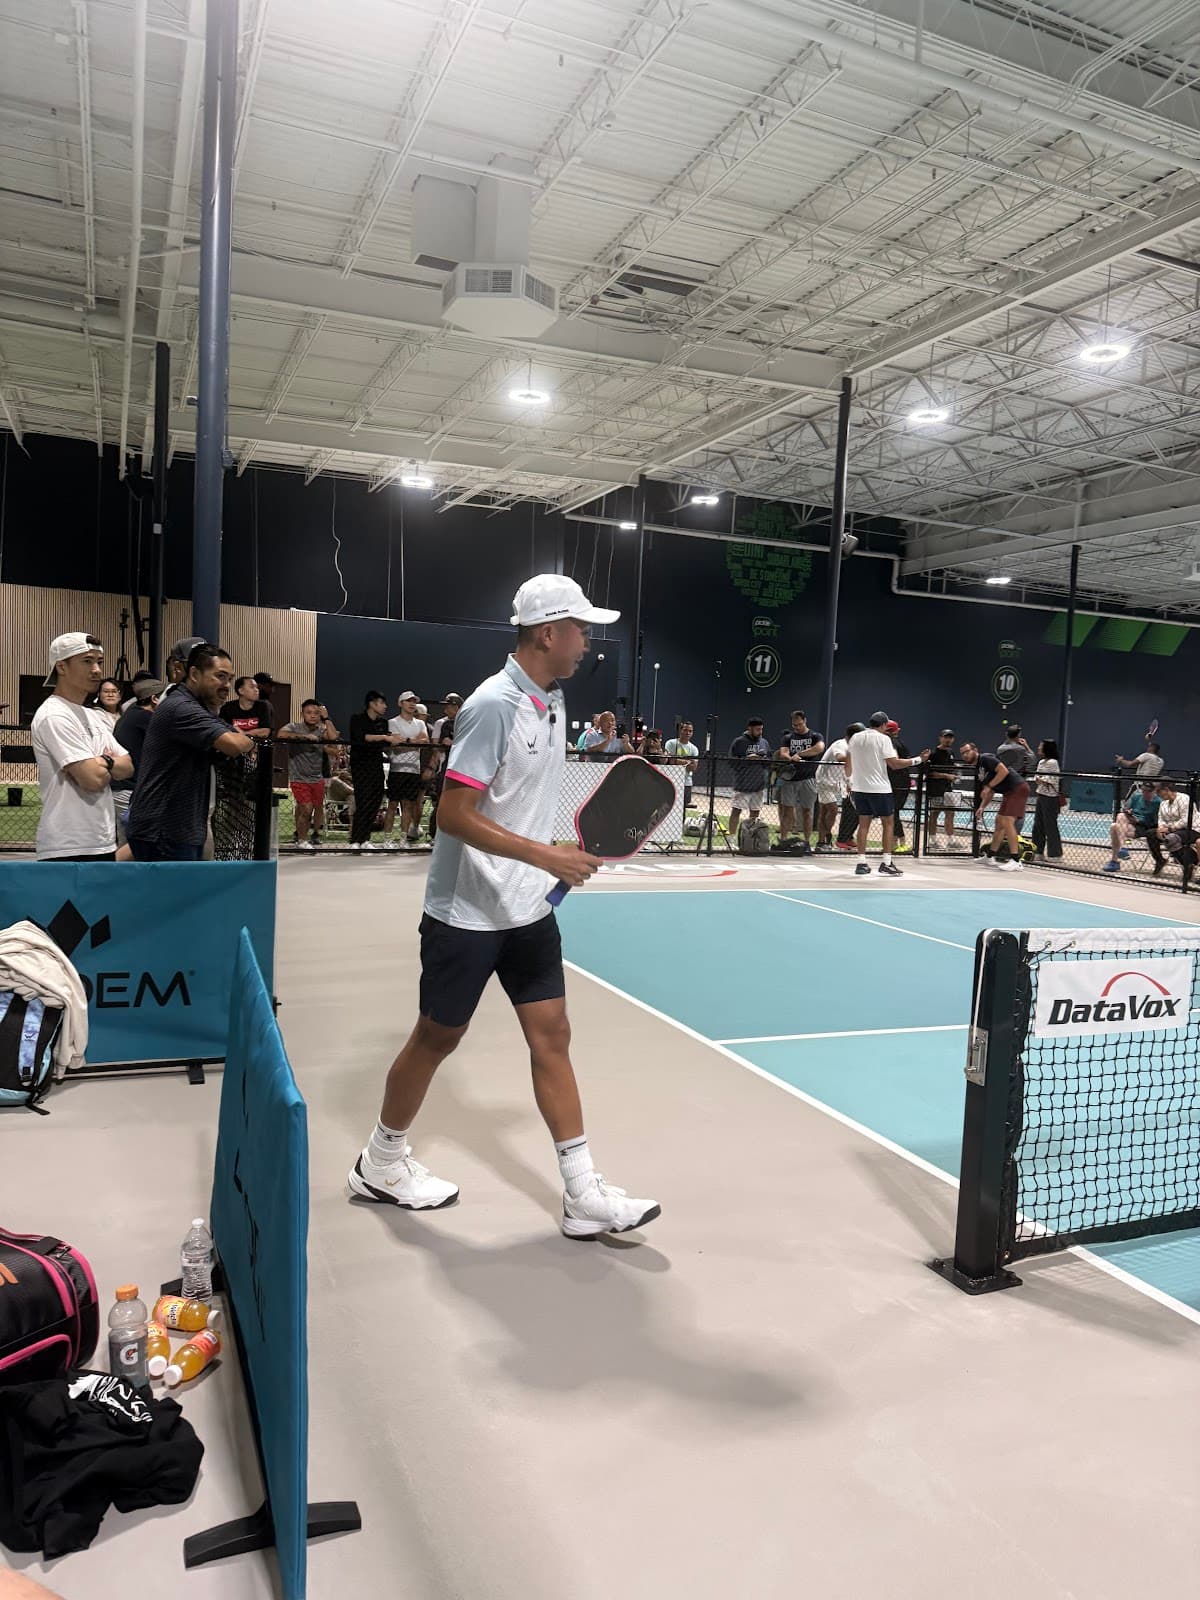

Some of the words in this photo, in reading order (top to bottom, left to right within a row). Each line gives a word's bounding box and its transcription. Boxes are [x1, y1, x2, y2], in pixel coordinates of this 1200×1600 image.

[754, 654, 772, 673] 11
[999, 673, 1015, 691] 10
[1048, 994, 1181, 1025] DataVox
[120, 1342, 139, 1365] G
